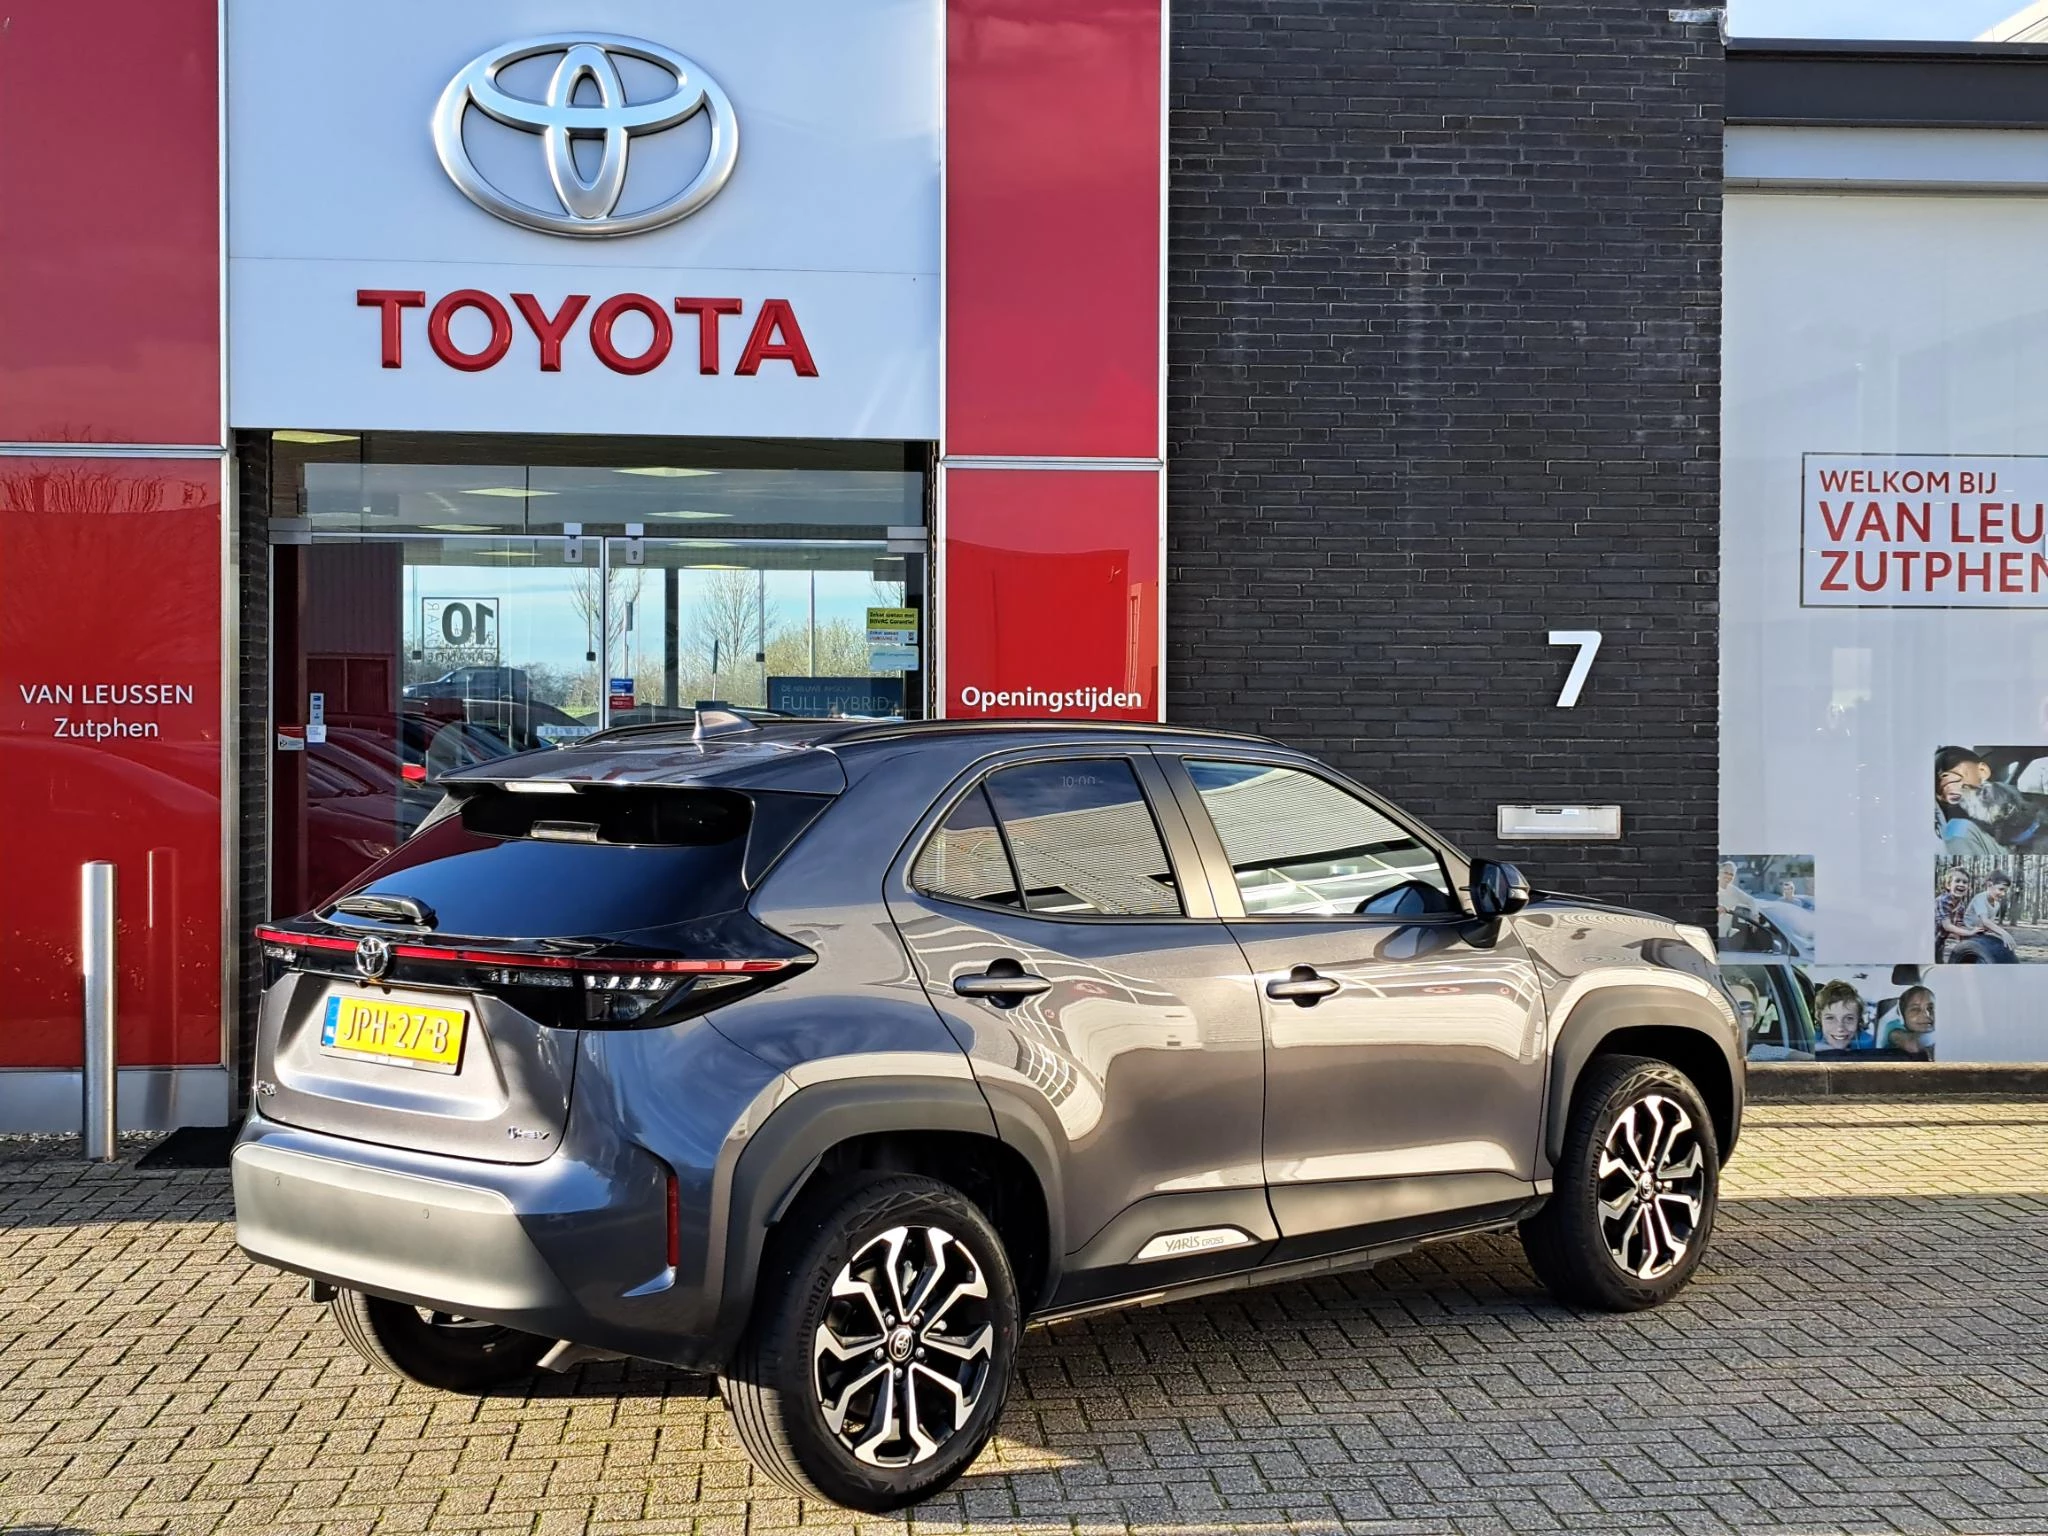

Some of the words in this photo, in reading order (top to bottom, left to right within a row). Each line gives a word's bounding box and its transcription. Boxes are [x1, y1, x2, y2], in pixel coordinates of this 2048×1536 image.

[356, 288, 819, 378] TOYOTA
[1819, 470, 1950, 494] WELKOM
[1959, 471, 1997, 494] BIJ
[1819, 501, 1932, 543] VAN
[1548, 630, 1603, 707] 7
[20, 684, 73, 704] VAN
[82, 684, 193, 704] LEUSSEN
[782, 696, 820, 711] FULL
[827, 696, 889, 711] HYBRID
[961, 686, 1143, 713] Openingstijden
[53, 717, 159, 742] Zutphen
[343, 1006, 450, 1054] JPH-27-B
[1165, 1235, 1201, 1252] YARIS
